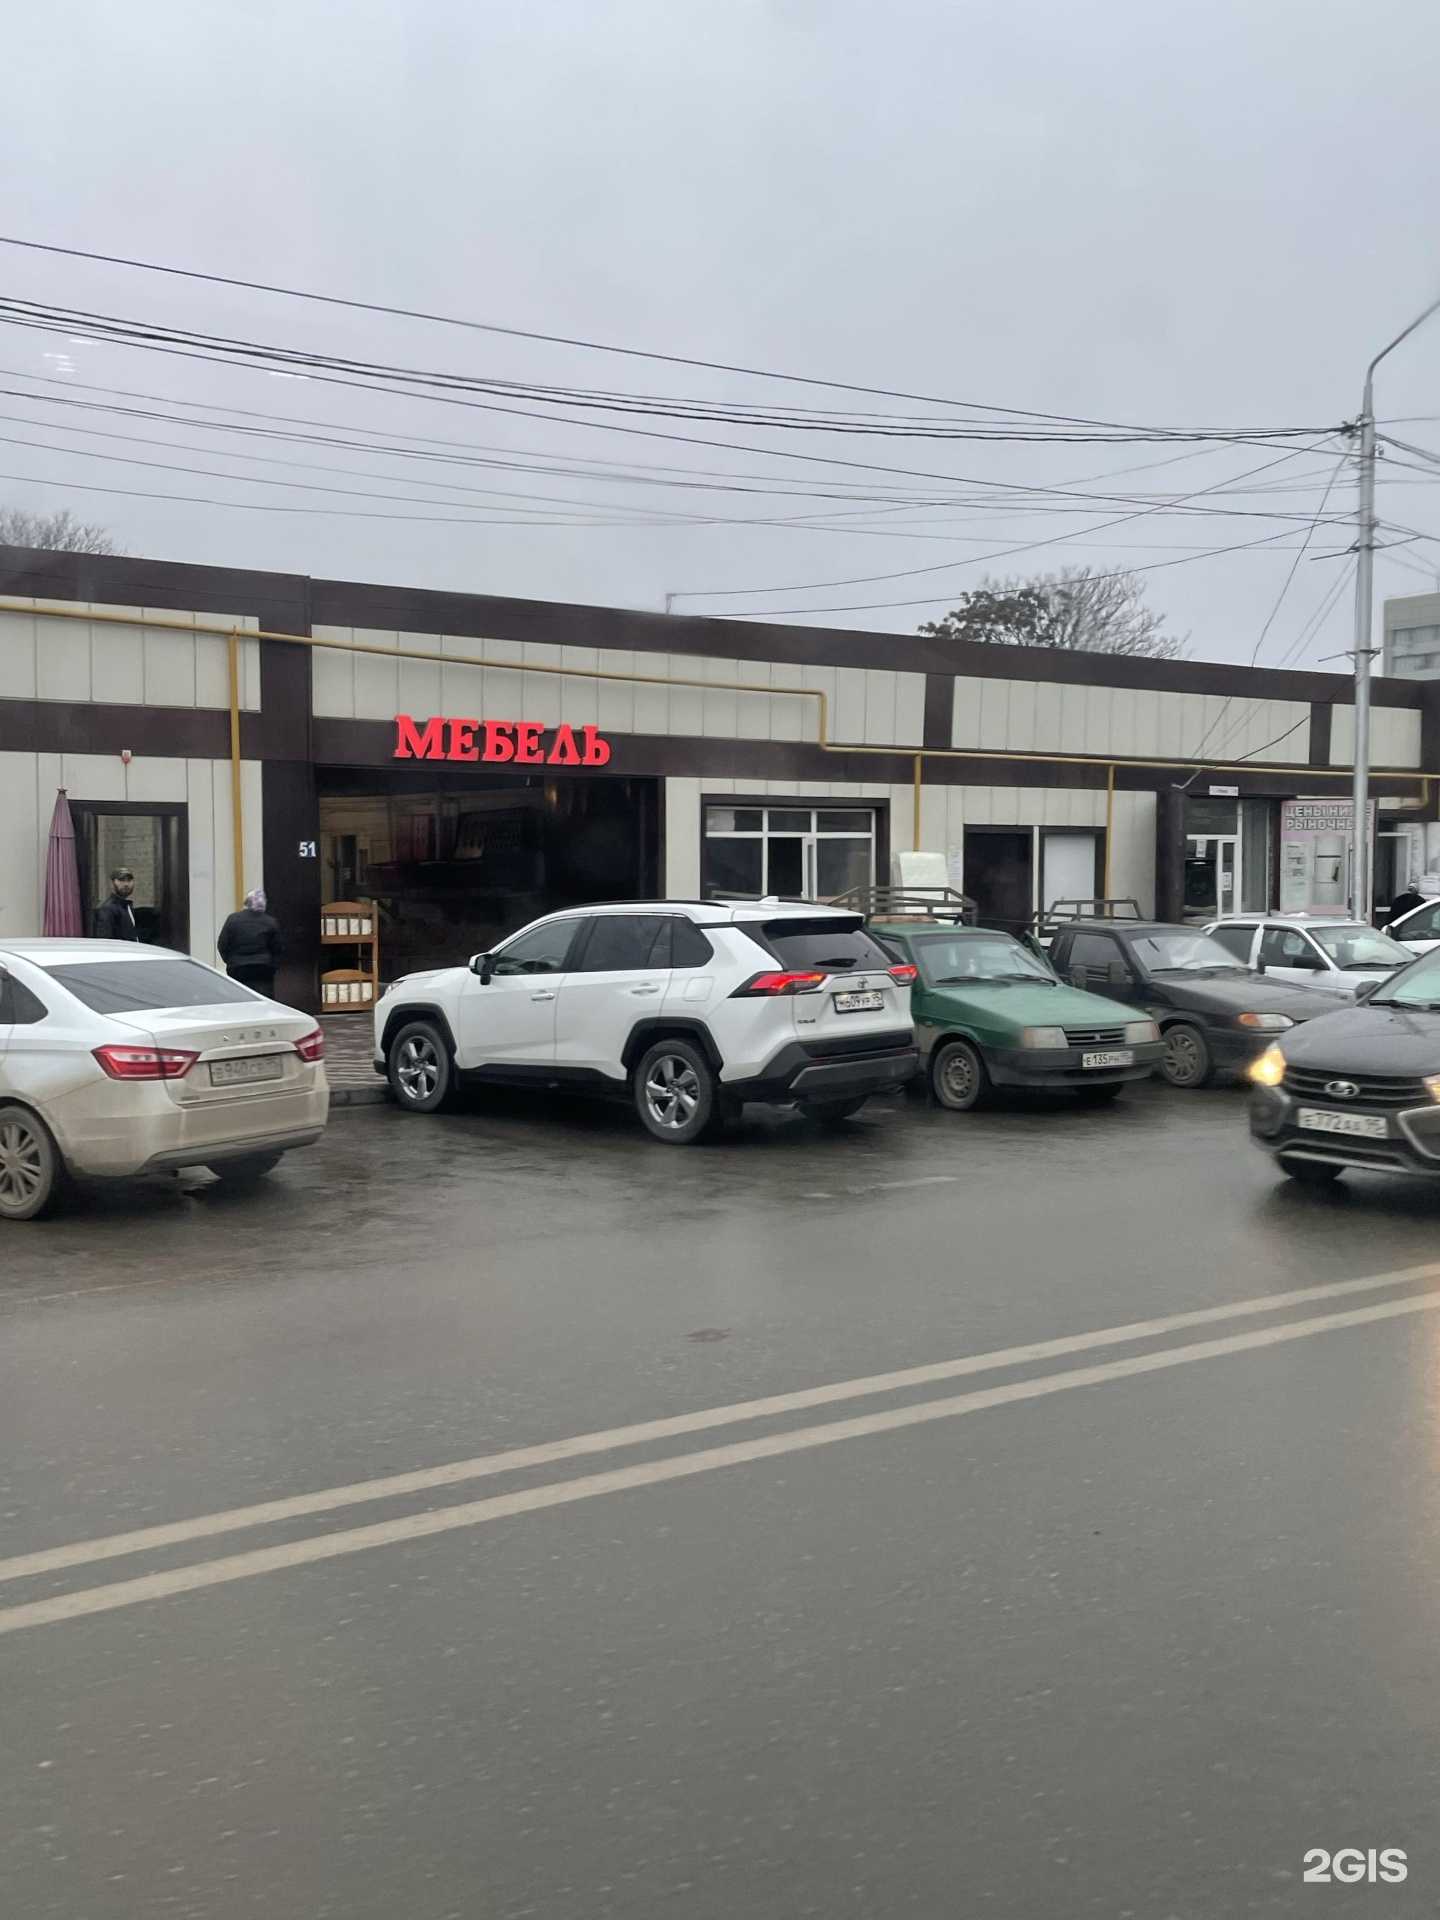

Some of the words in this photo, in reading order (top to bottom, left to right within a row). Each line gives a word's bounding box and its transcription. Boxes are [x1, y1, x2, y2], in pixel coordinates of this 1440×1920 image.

[392, 714, 611, 766] МЕБЕЛЬ
[1285, 805, 1327, 818] ЦЕНЫ
[299, 841, 317, 857] 51
